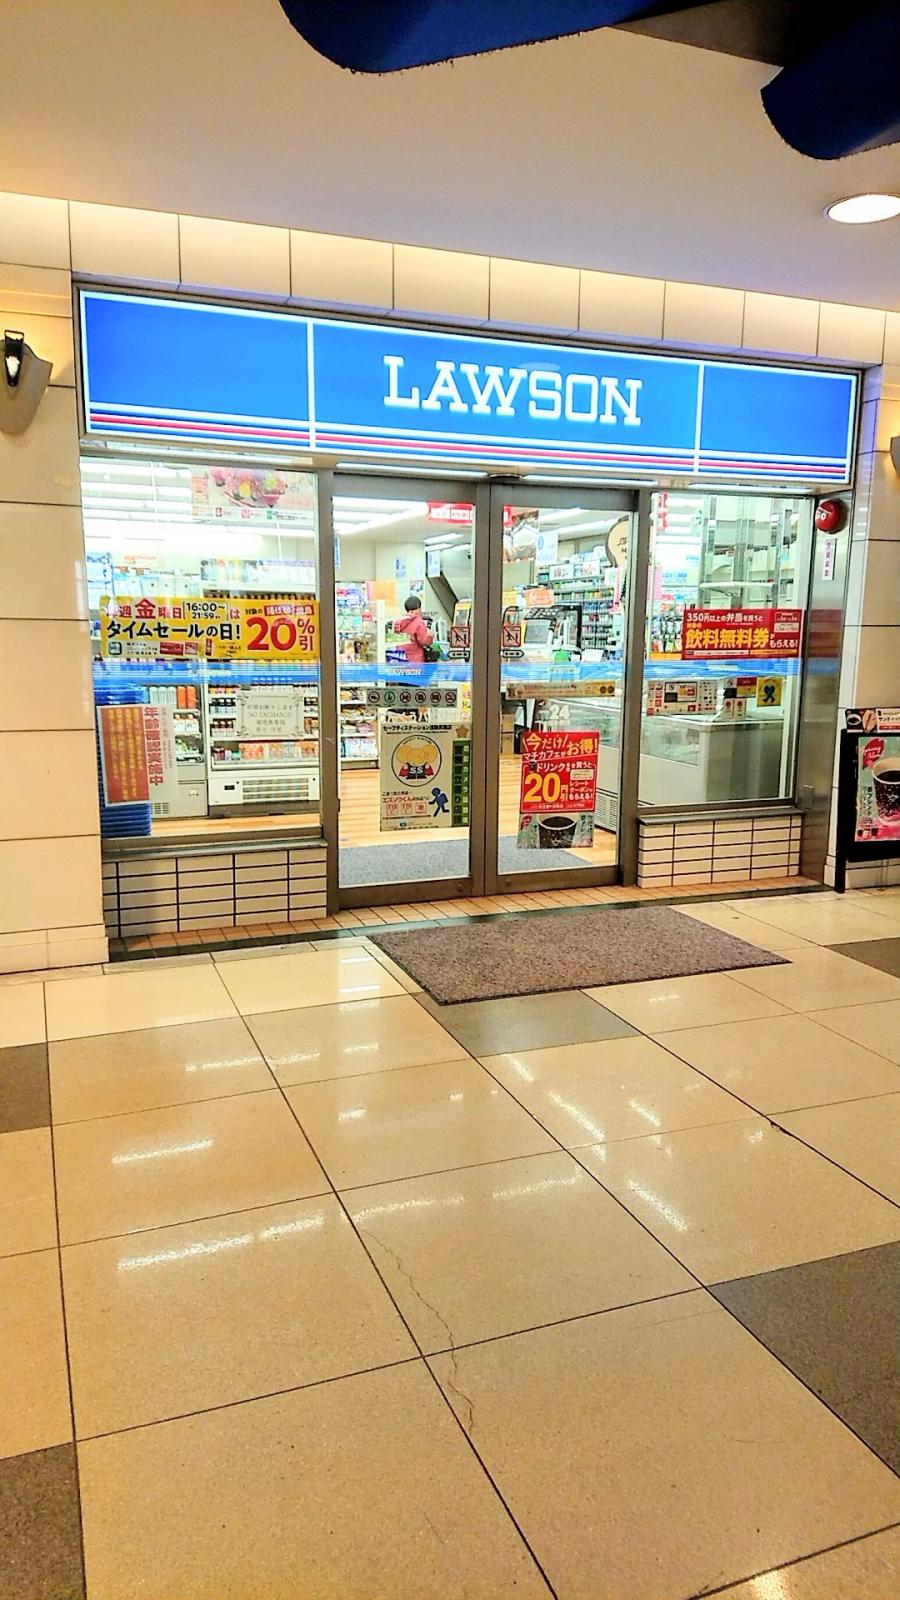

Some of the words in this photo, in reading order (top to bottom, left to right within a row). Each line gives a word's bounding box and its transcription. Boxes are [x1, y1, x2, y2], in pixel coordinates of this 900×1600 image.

[383, 355, 643, 425] LAWSON
[686, 628, 769, 648] 飲料無料券
[526, 733, 564, 750] 今だけ
[567, 738, 598, 756] お得!
